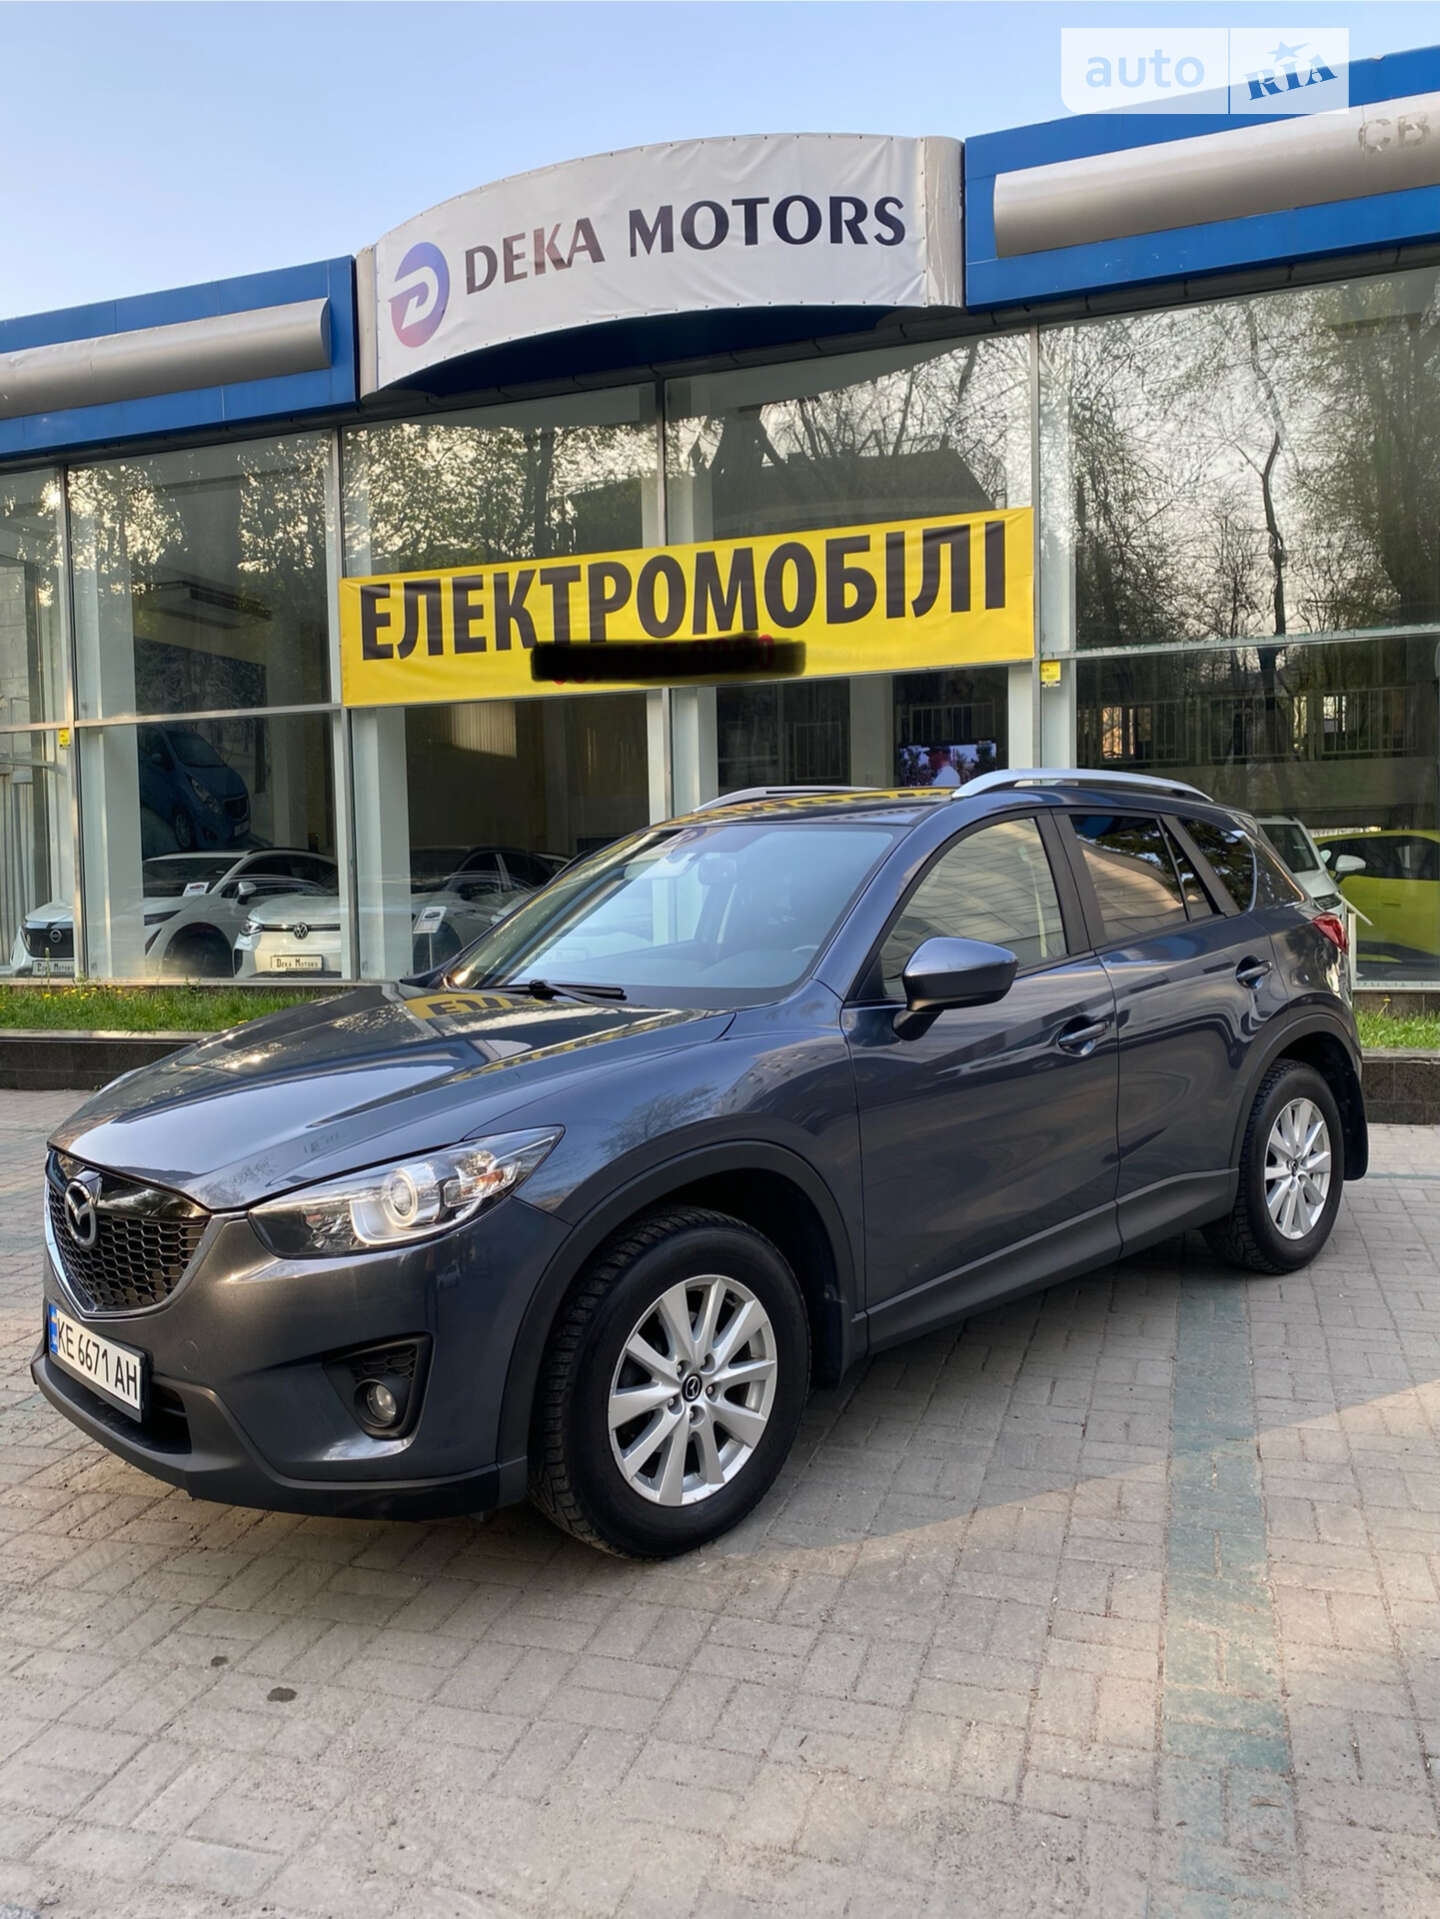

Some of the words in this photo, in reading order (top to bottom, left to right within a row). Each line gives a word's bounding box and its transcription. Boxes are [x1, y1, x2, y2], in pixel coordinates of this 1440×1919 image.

[465, 217, 606, 296] DEKA
[629, 195, 907, 258] MOTORS
[361, 520, 1007, 661] ЕЛЕКТРОМОБІЛІ
[57, 1318, 75, 1361] KE
[78, 1333, 109, 1383] 6671
[115, 1355, 138, 1400] AH
